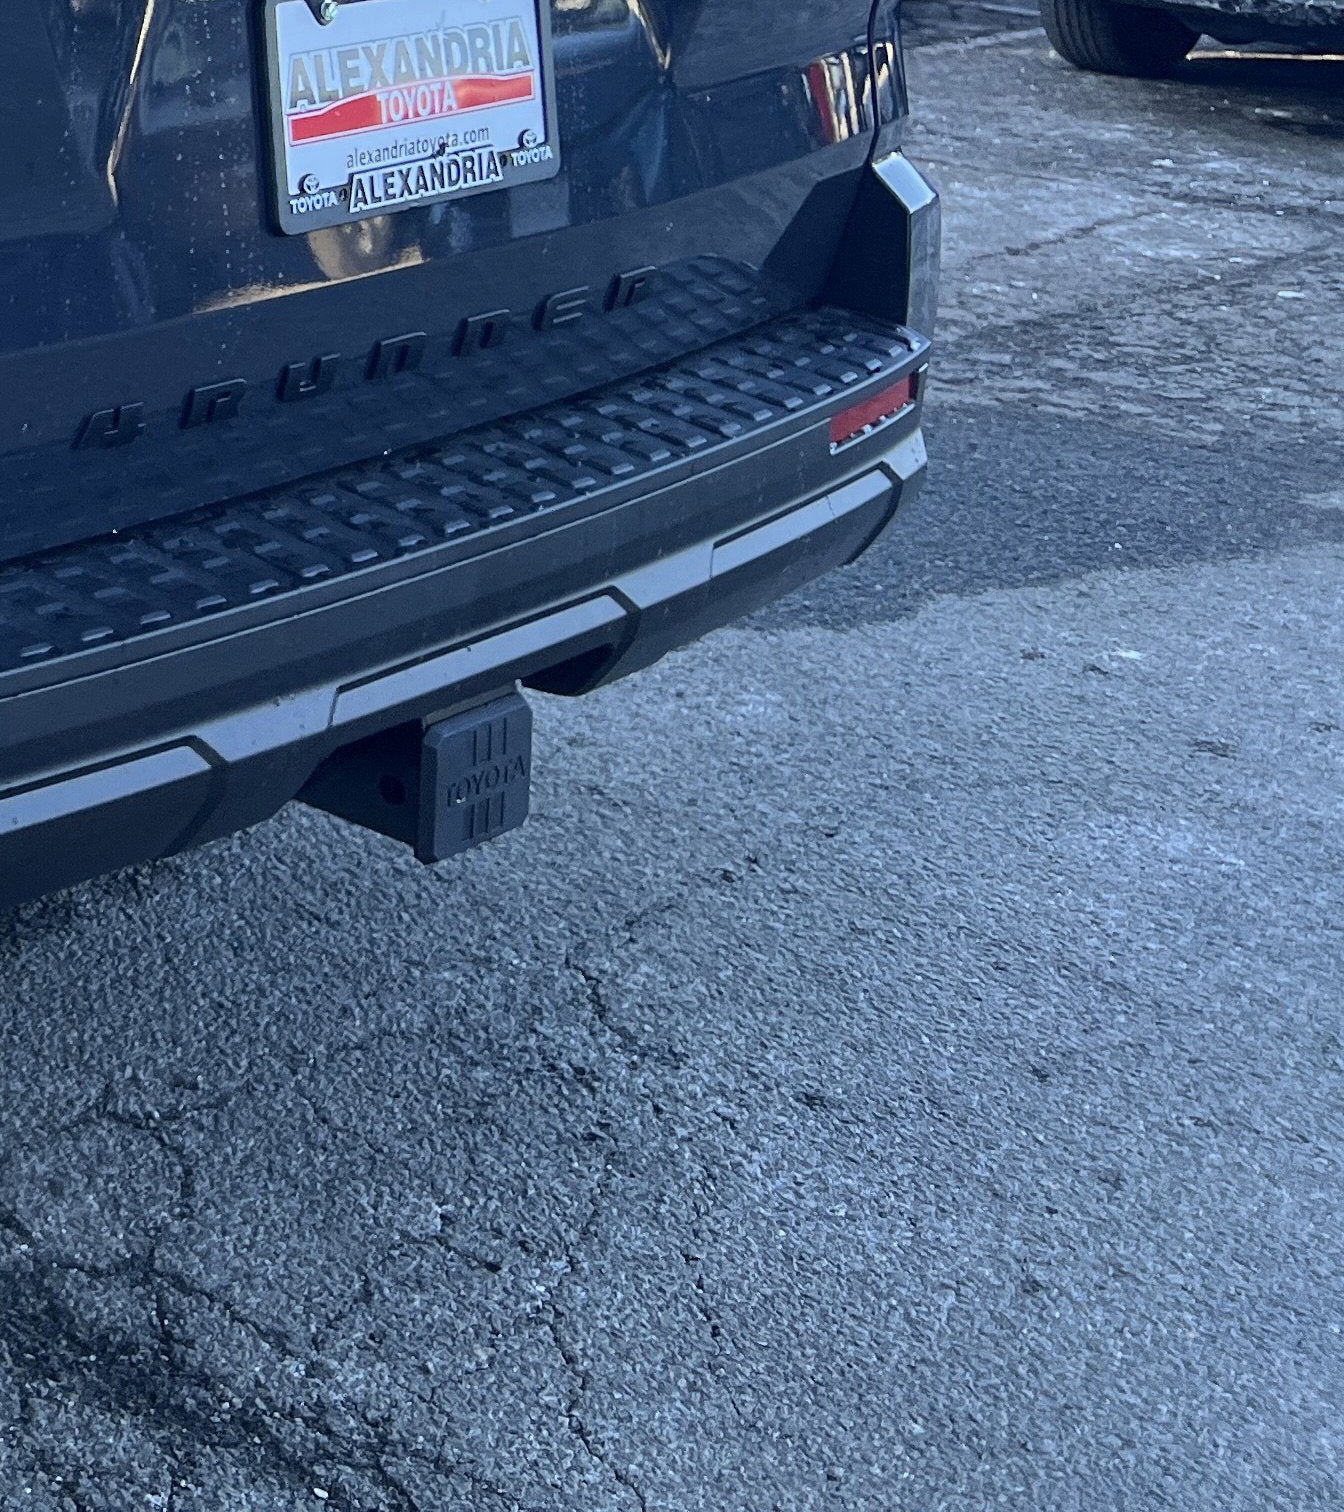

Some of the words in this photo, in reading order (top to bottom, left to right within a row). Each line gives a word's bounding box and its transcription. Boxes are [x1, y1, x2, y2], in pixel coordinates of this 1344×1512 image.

[288, 19, 531, 111] ALEXANDRIA
[377, 82, 457, 125] TOYOTA
[346, 127, 490, 169] alexandriatoyota.com
[289, 190, 339, 214] TOYOTA
[349, 150, 504, 213] ALEXANDRIA
[511, 145, 554, 168] TOYOTA
